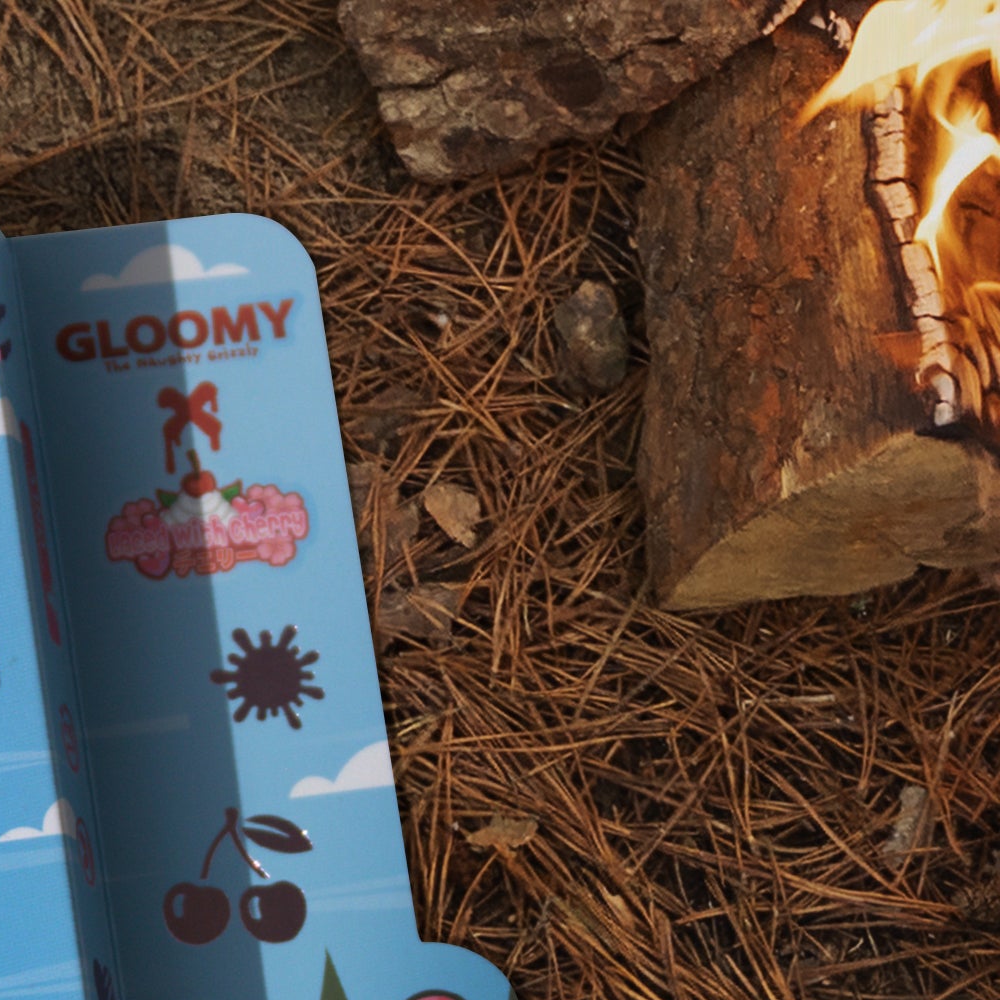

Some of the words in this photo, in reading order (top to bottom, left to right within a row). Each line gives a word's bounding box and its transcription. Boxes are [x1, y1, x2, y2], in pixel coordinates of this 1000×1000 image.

[56, 299, 295, 363] GLOOMY
[208, 345, 259, 363] Grizzly
[171, 514, 229, 552] with
[230, 507, 308, 543] Cherry
